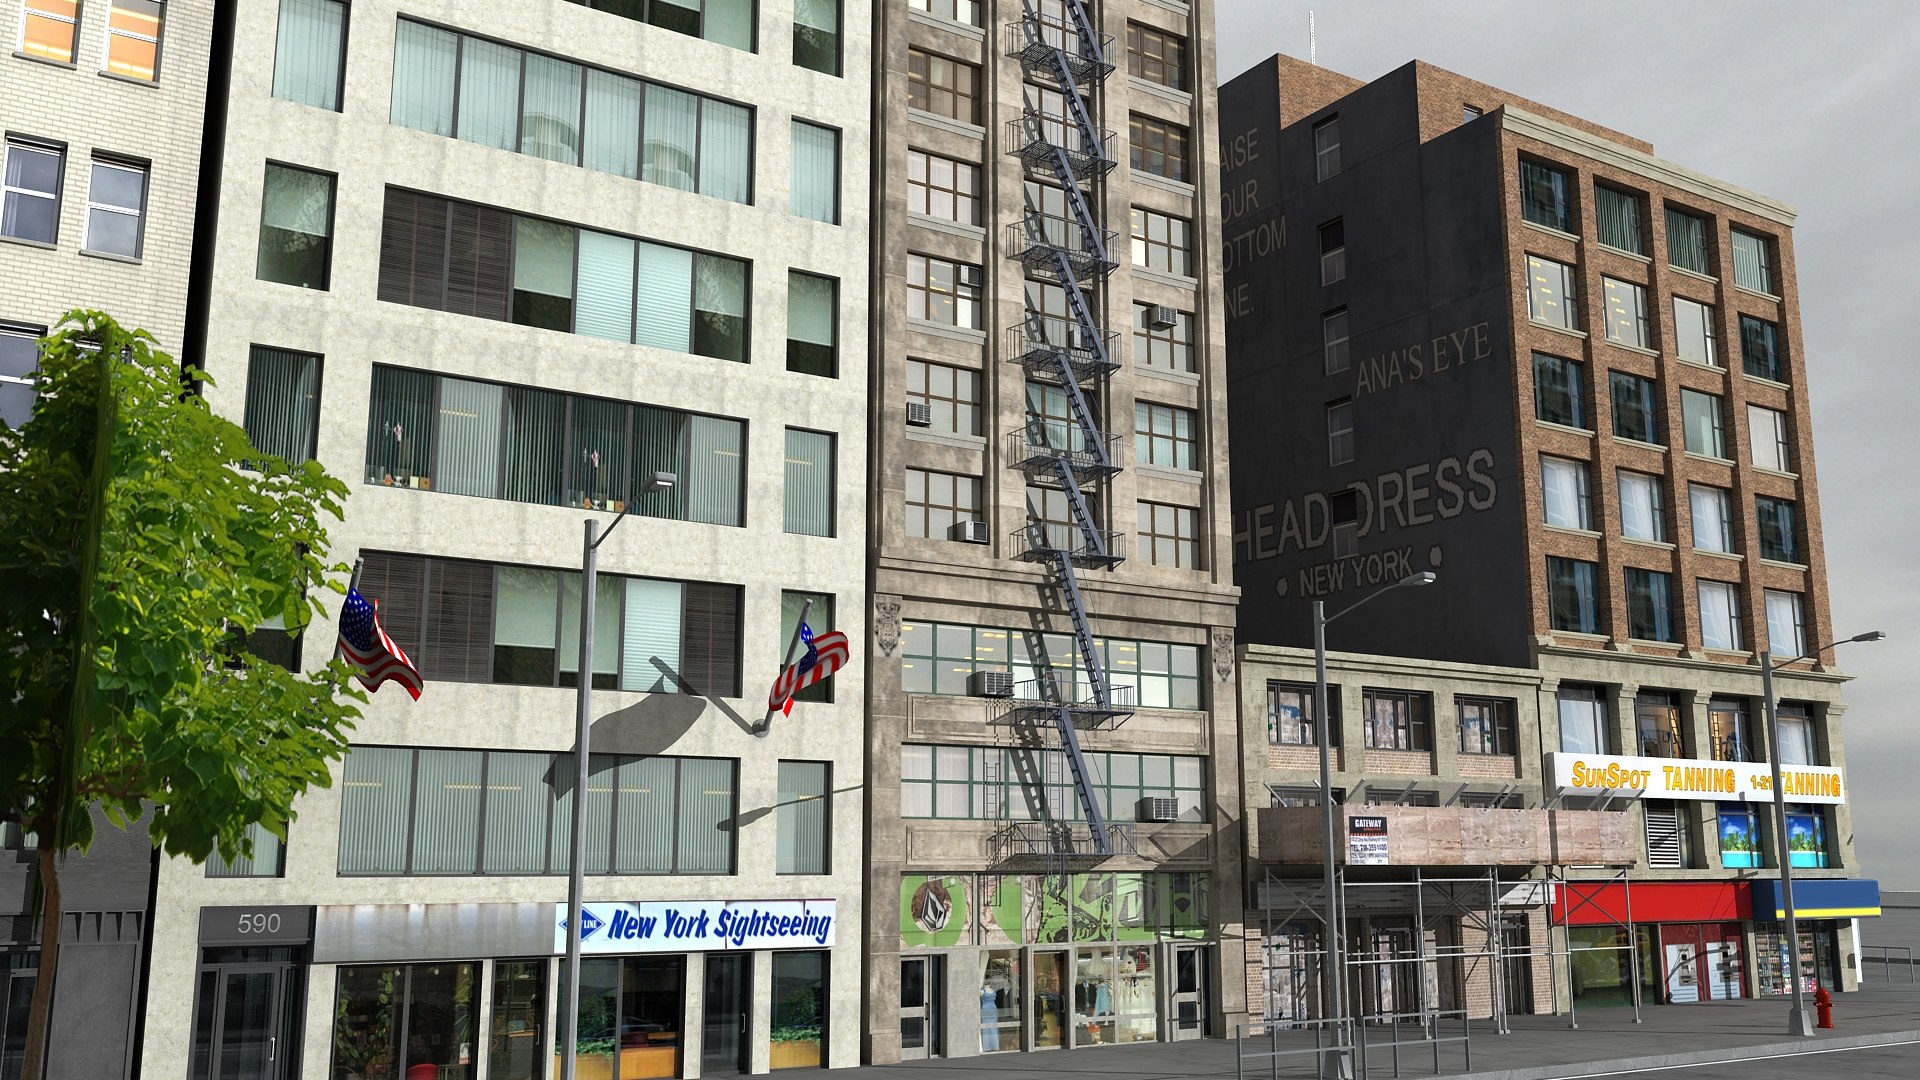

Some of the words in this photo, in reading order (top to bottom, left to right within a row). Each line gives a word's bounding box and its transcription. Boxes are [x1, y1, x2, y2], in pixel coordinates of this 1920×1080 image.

[1220, 127, 1259, 172] AISE
[1221, 179, 1259, 224] OUR
[1223, 214, 1287, 273] OTTOM
[1225, 283, 1255, 322] NE.
[1356, 343, 1424, 398] ANA'S
[1432, 321, 1492, 373] EYE
[1299, 558, 1345, 598] NEW
[1352, 546, 1414, 587] YORK
[1663, 765, 1736, 793] TANNING
[1751, 774, 1774, 790] 1-21
[1355, 819, 1382, 828] GATEWAY
[238, 913, 281, 934] 590
[584, 919, 598, 929] LINE
[607, 909, 658, 940] New
[664, 908, 710, 939] York
[713, 908, 832, 946] Sightseeing
